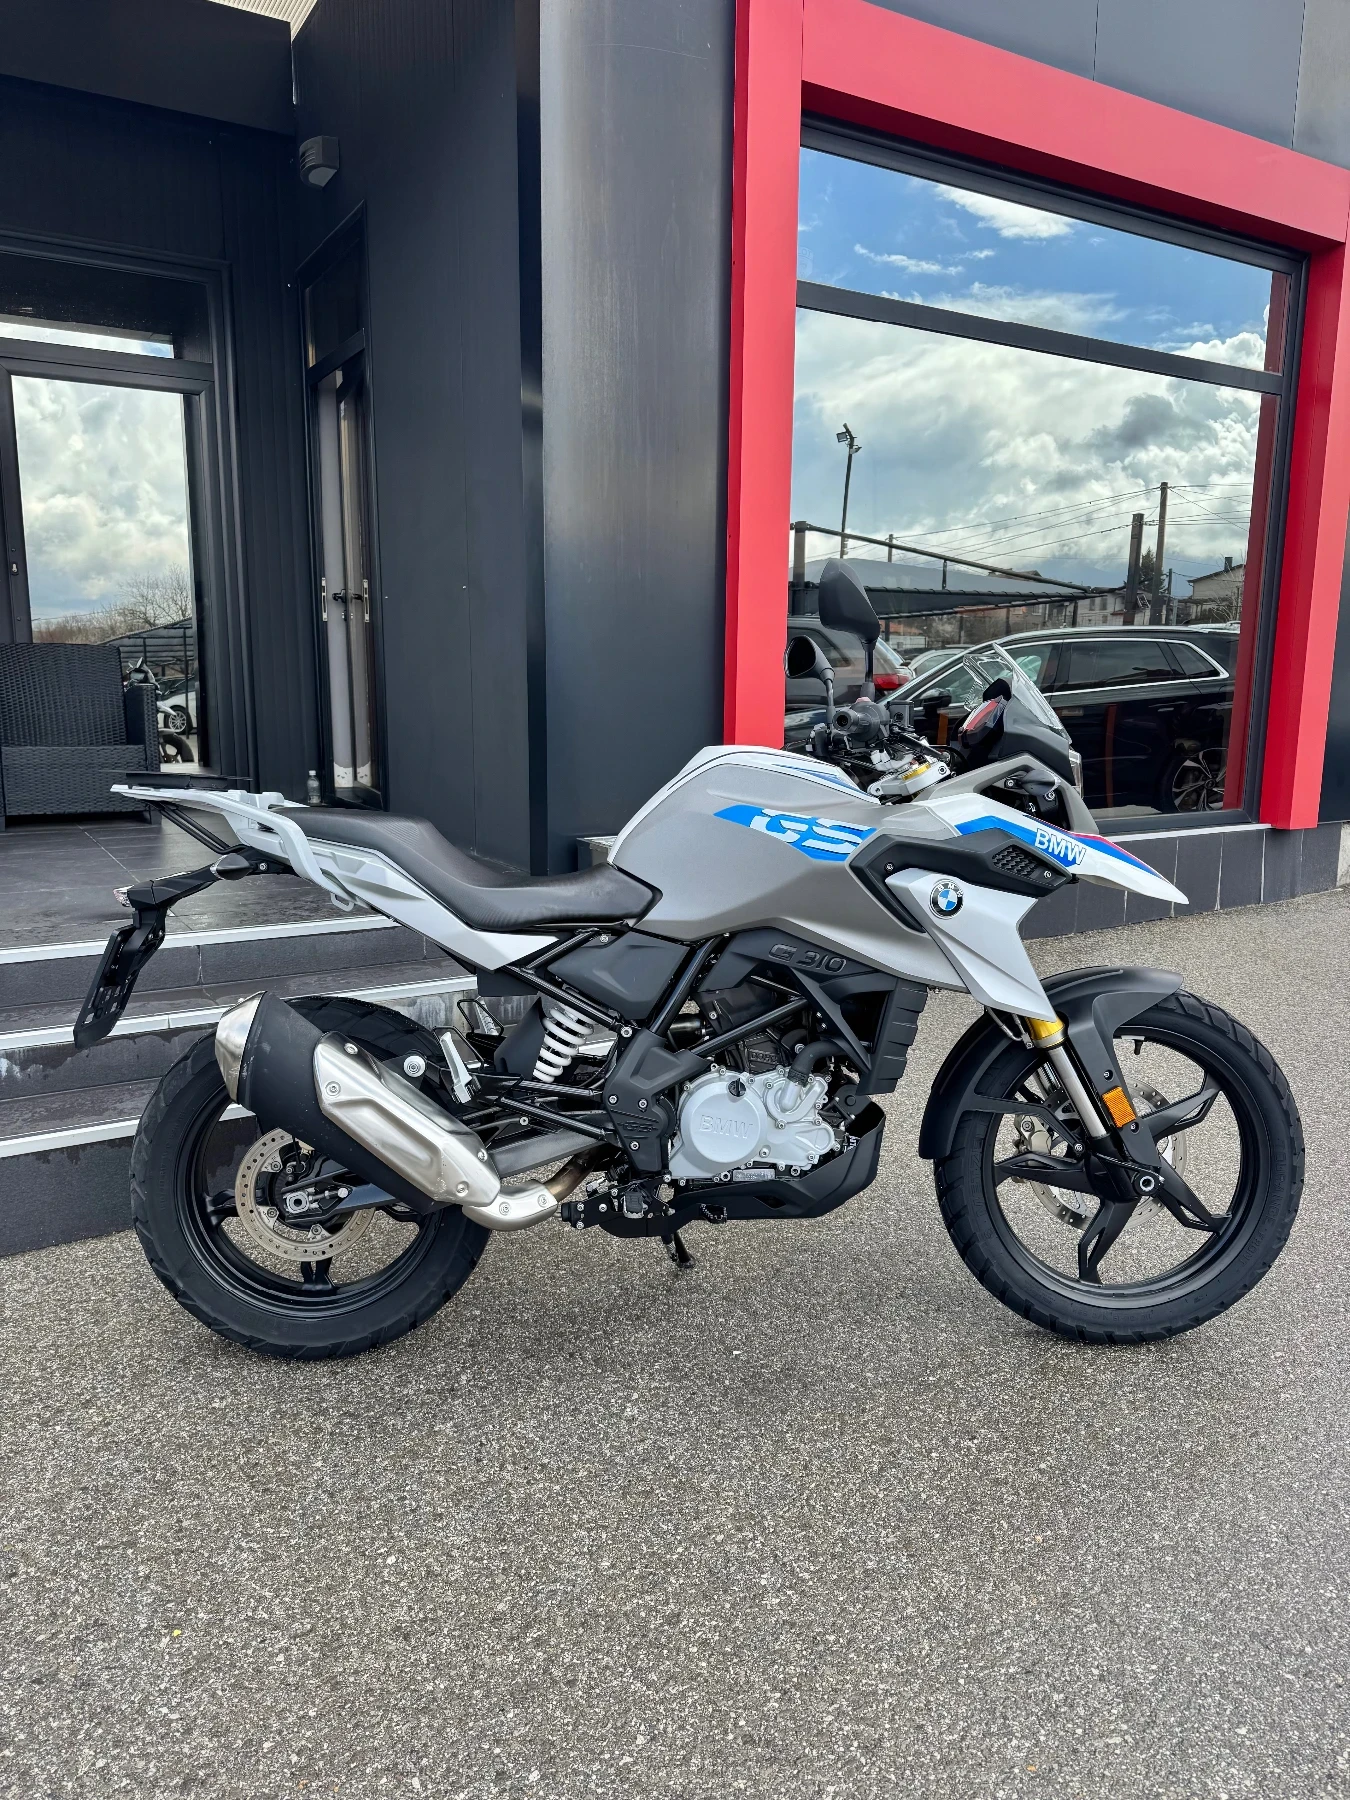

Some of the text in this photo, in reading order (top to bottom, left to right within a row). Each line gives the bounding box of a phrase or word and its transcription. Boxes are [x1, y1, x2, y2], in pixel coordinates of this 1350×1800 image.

[750, 808, 874, 855] GS
[1034, 827, 1087, 866] BMW
[768, 943, 847, 974] G 310
[699, 1114, 754, 1140] BMW
